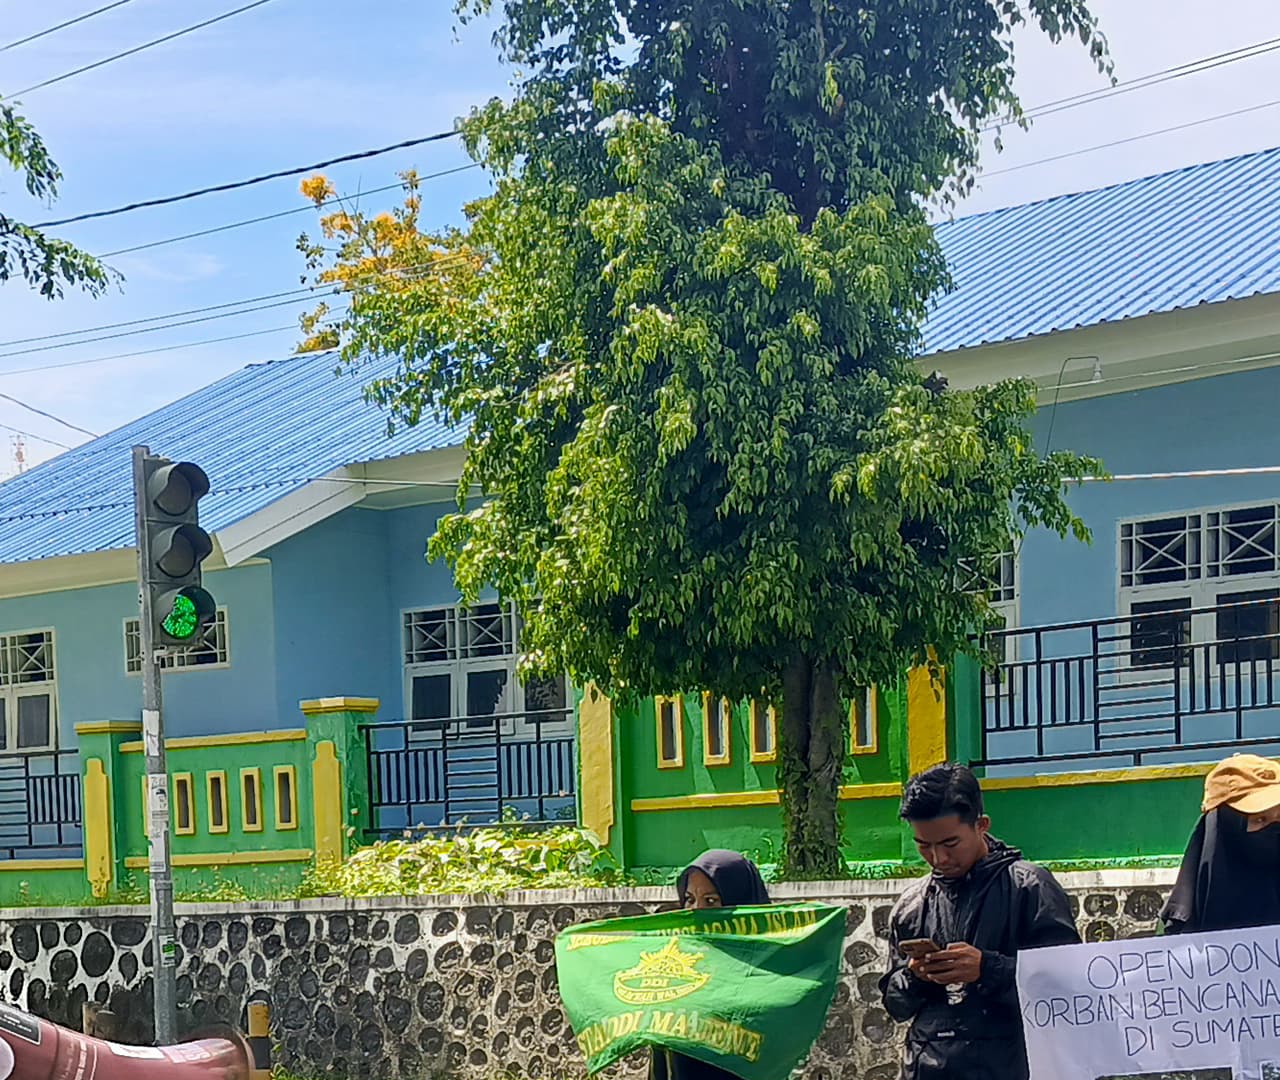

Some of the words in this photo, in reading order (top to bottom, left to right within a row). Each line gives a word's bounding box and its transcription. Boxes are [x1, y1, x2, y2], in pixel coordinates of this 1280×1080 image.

[1088, 947, 1195, 989] OPEN
[1022, 991, 1135, 1029] KORBAN
[1143, 979, 1280, 1020] BENCANA
[1124, 1025, 1155, 1057] DI
